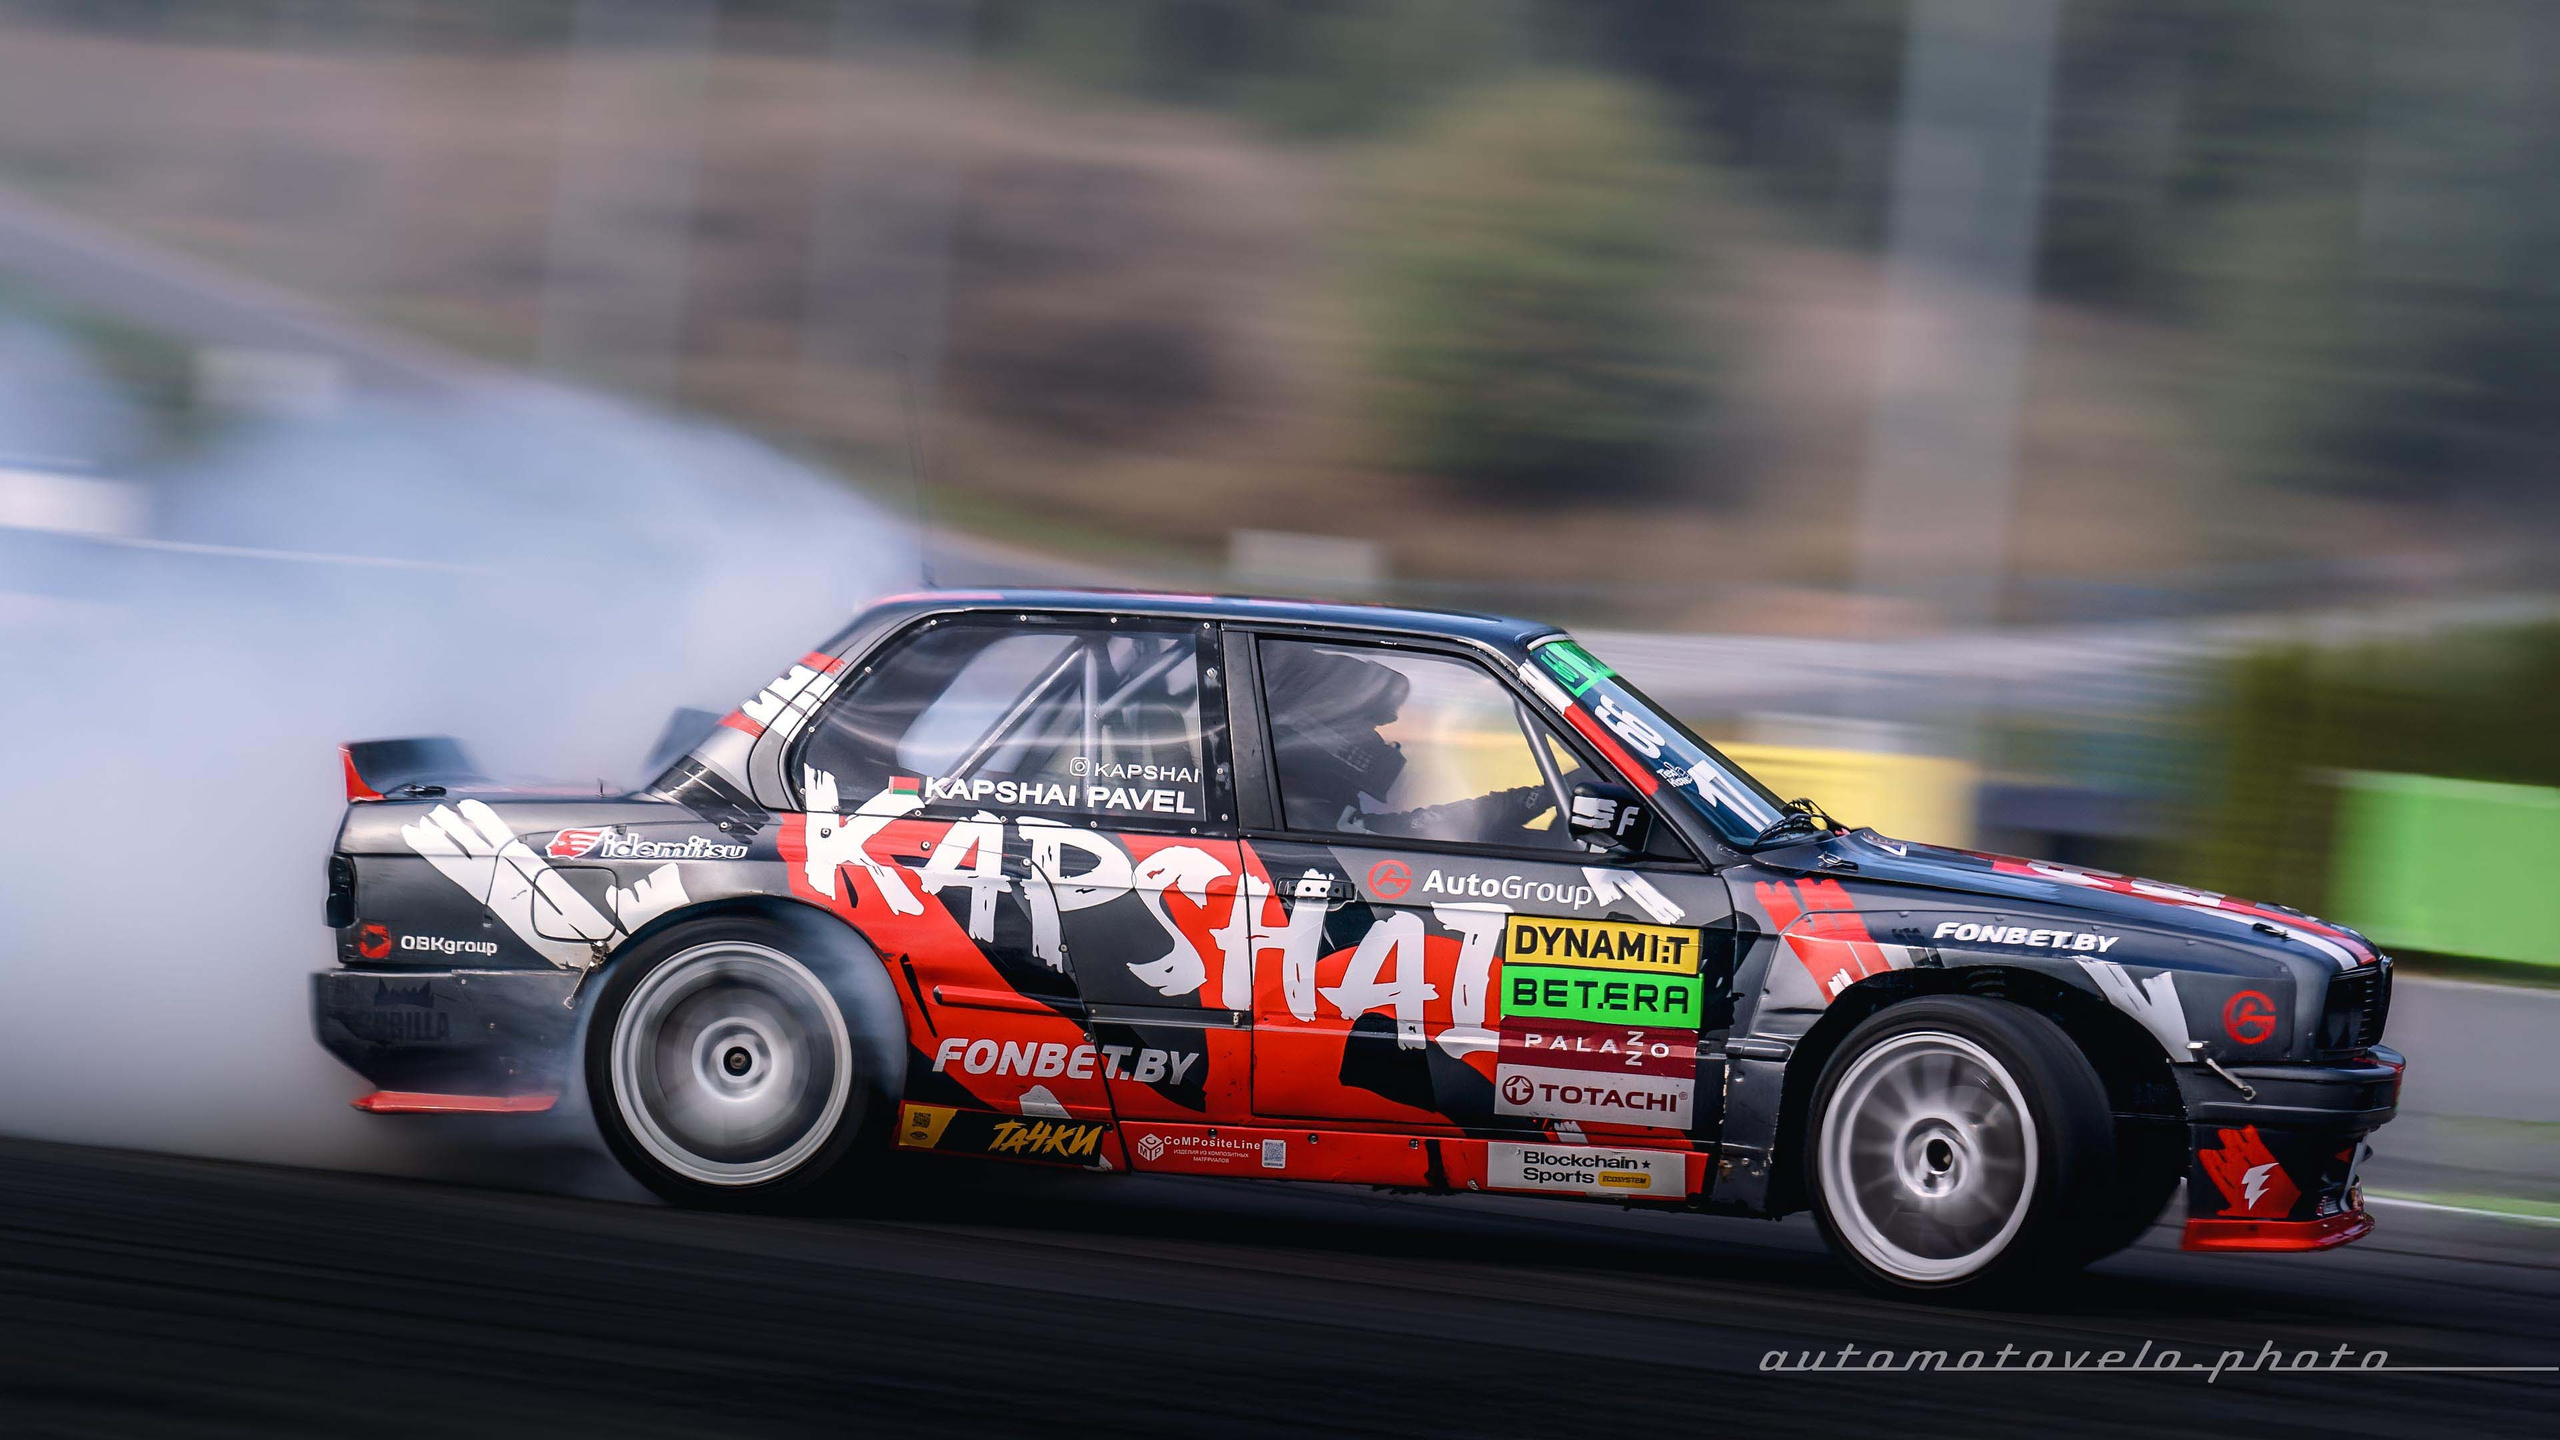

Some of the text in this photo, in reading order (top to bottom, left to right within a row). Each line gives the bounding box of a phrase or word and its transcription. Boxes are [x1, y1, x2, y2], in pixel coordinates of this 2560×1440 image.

[1094, 762, 1200, 783] KAPSHAI
[924, 776, 1196, 815] KAPSHAI PAVEL
[600, 832, 748, 860] idemitsu
[1421, 868, 1593, 911] AutoGroup
[803, 762, 1514, 1060] KAPSHAI
[400, 935, 498, 956] OBKgroup
[1932, 921, 2120, 953] FONBET.BY
[932, 1036, 1200, 1086] FONBET.BY
[1163, 1135, 1261, 1150] CoMPositeLine
[1523, 1150, 1638, 1170] Blockchain
[1523, 1167, 1647, 1185] Sports ECOSYSTEM
